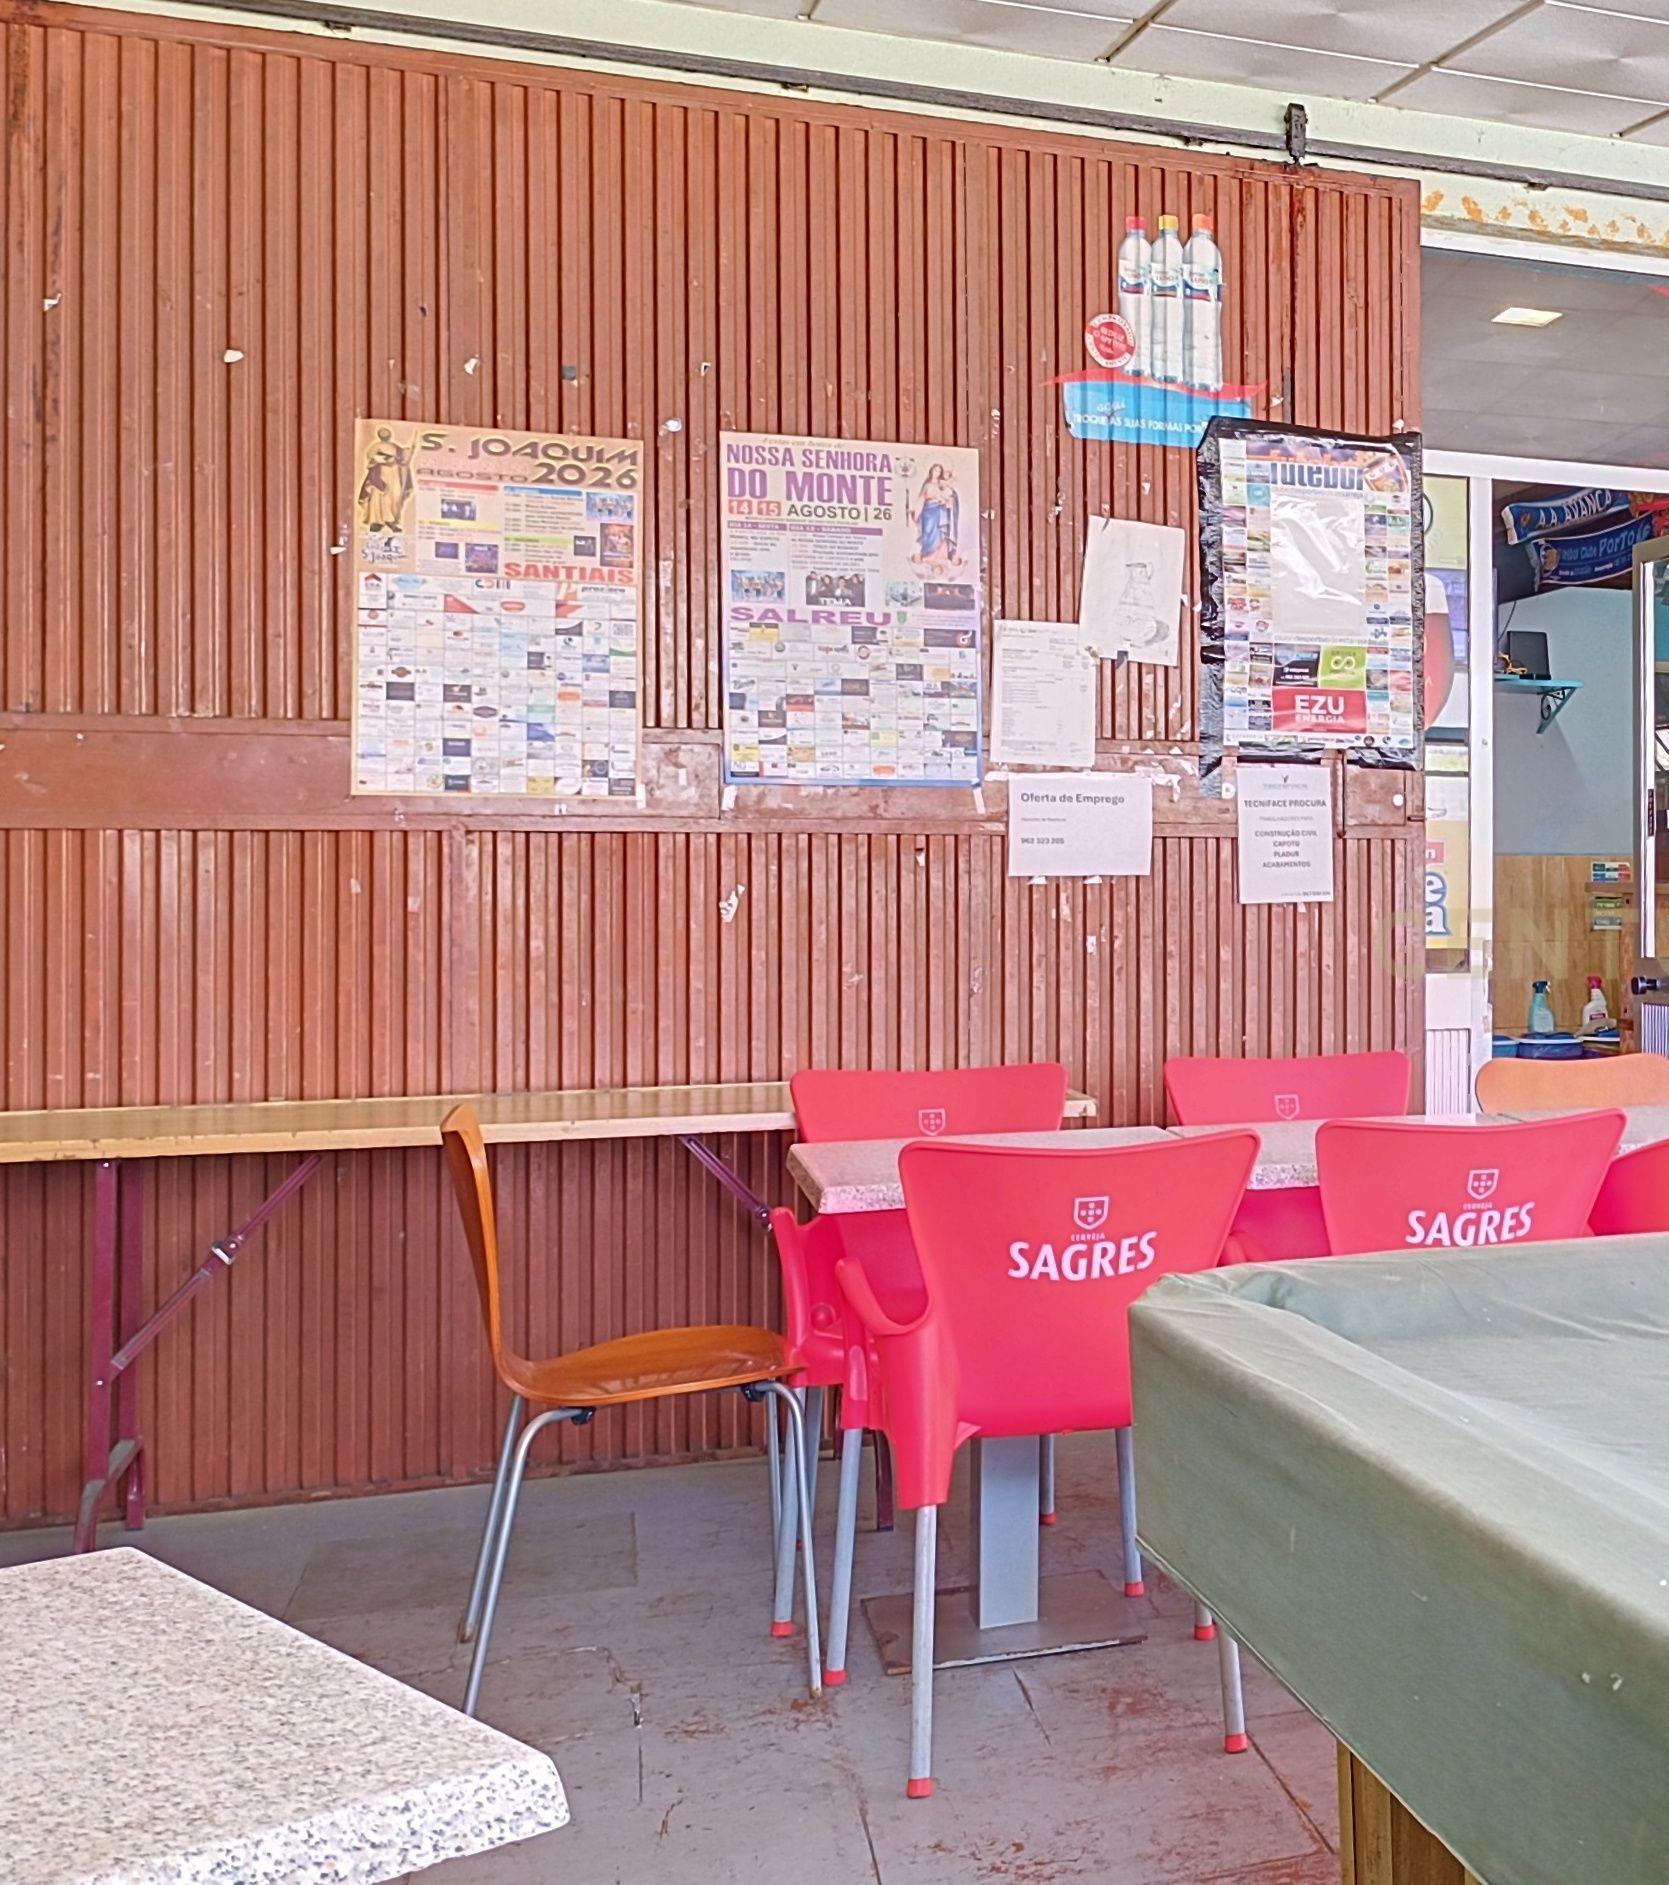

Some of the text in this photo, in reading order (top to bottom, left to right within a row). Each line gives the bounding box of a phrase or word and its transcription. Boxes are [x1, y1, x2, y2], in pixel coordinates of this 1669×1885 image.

[420, 433, 639, 465] S. JOAQUIM
[726, 443, 893, 473] NOSSA SENHORA
[416, 461, 638, 489] AGOSTO 2026
[727, 467, 894, 507] DO MONTE
[759, 502, 779, 516] 15
[787, 504, 861, 519] AGOSTO
[873, 507, 893, 521] 26
[504, 562, 635, 583] SANTIAIS
[730, 607, 892, 626] SALREU
[1294, 694, 1346, 715] EZU
[1020, 792, 1125, 806] Oferta de Emprego
[1288, 799, 1327, 808] PROCURA
[1405, 1201, 1536, 1247] SAGRES
[1071, 1232, 1106, 1242] CERVEJA
[1007, 1230, 1158, 1282] SAGRES
